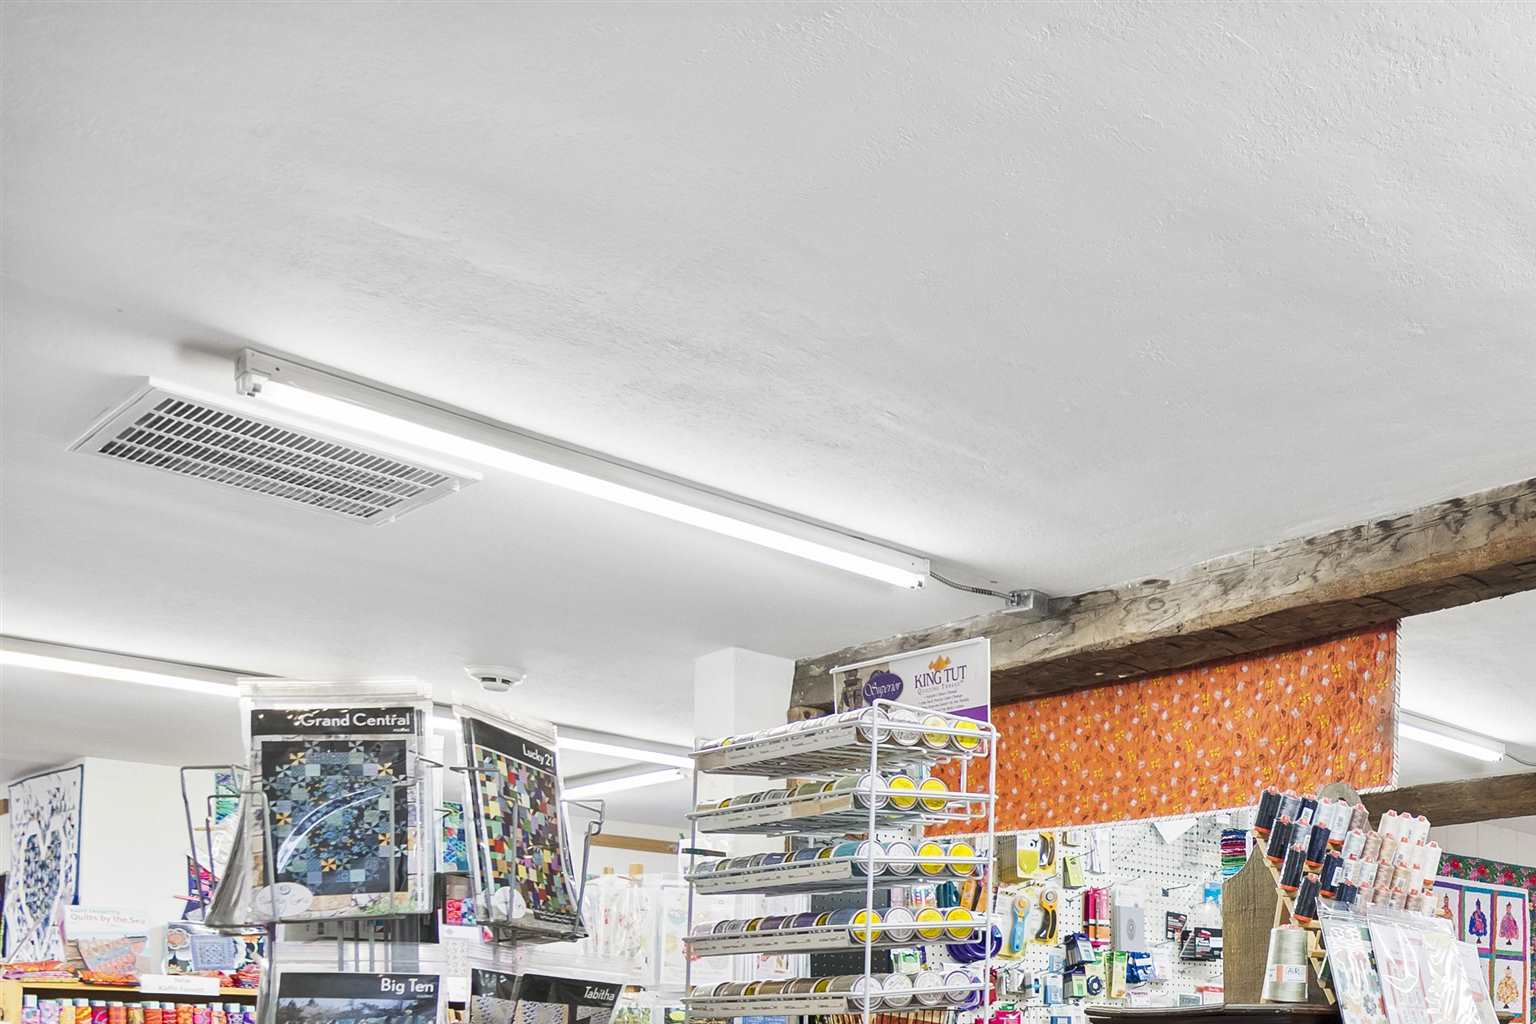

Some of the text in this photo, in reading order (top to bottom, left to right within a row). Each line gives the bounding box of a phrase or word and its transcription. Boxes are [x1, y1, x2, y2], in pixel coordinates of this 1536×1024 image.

[914, 665, 967, 689] KING TUT
[301, 712, 411, 727] Grand Central
[522, 743, 554, 767] Lucky 21
[381, 977, 434, 995] Big Ten
[584, 986, 615, 1000] Tabitha
